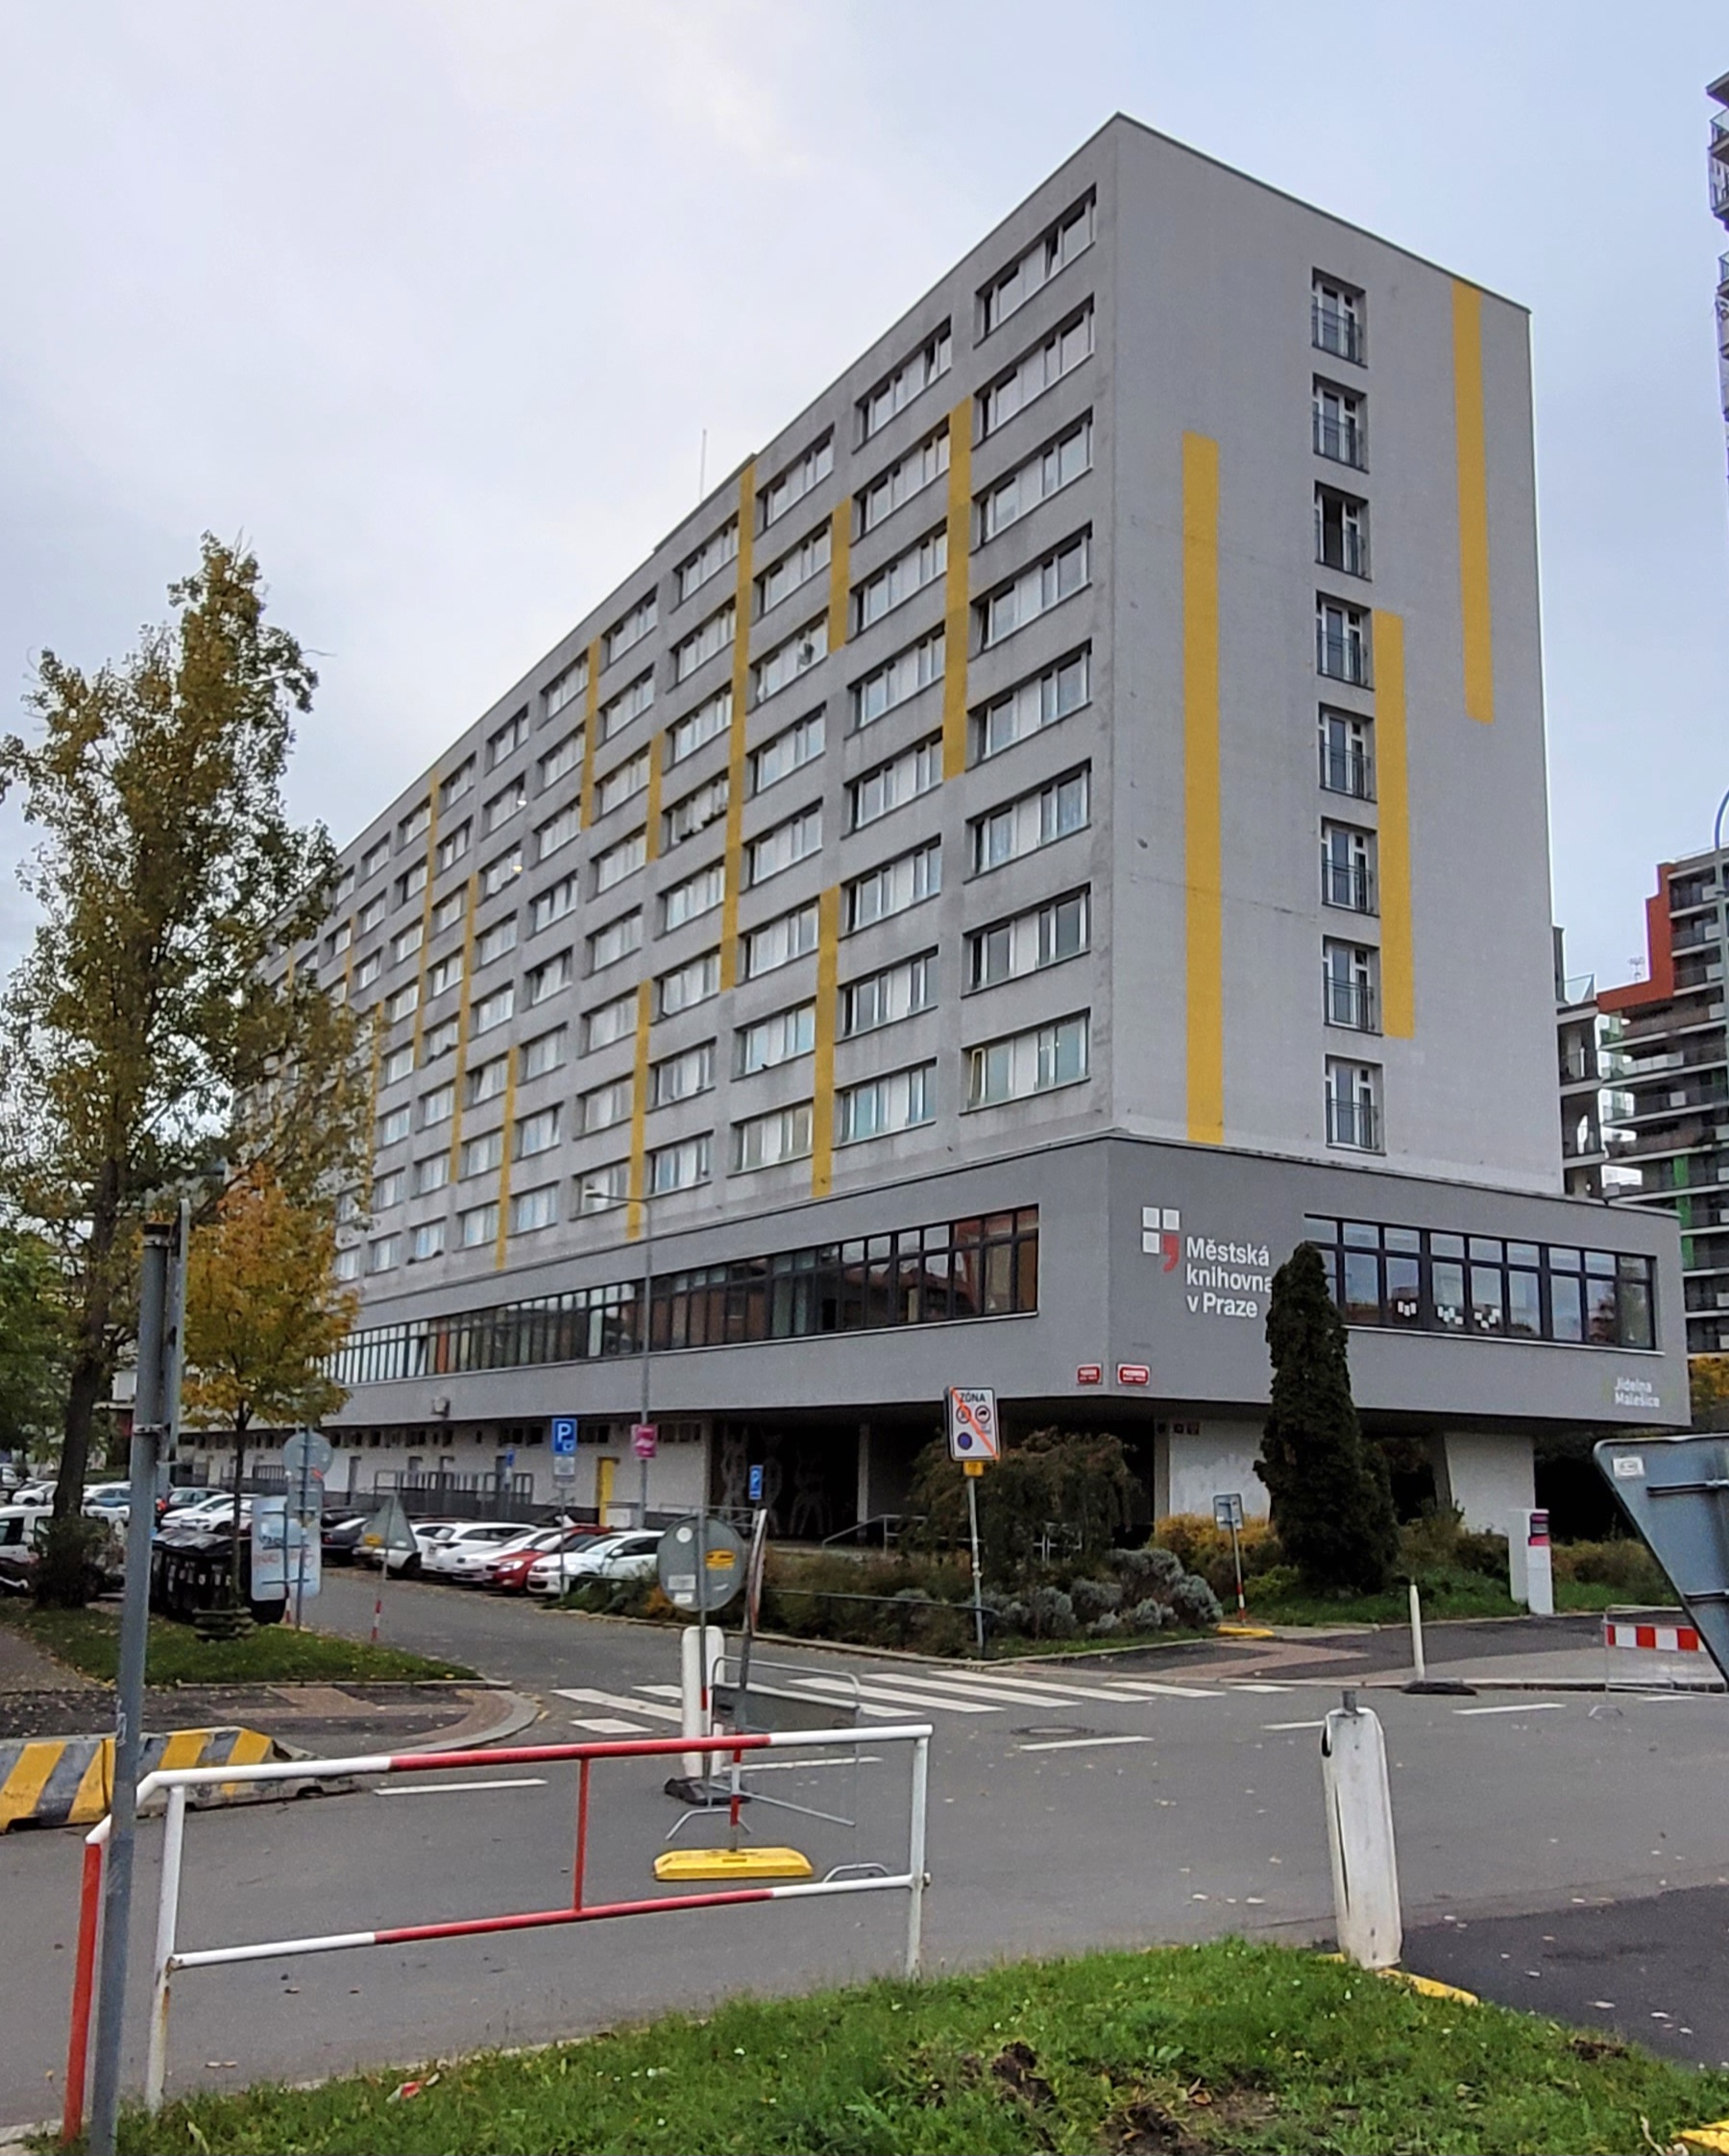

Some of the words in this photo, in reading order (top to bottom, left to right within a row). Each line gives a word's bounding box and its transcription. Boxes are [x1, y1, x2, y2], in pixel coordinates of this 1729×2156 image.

[1186, 1236, 1270, 1267] Městská
[1186, 1263, 1273, 1293] knihovna
[1186, 1296, 1199, 1313] v
[1203, 1292, 1258, 1318] Praze
[961, 1392, 986, 1402] ZÓNA
[557, 1423, 572, 1443] P
